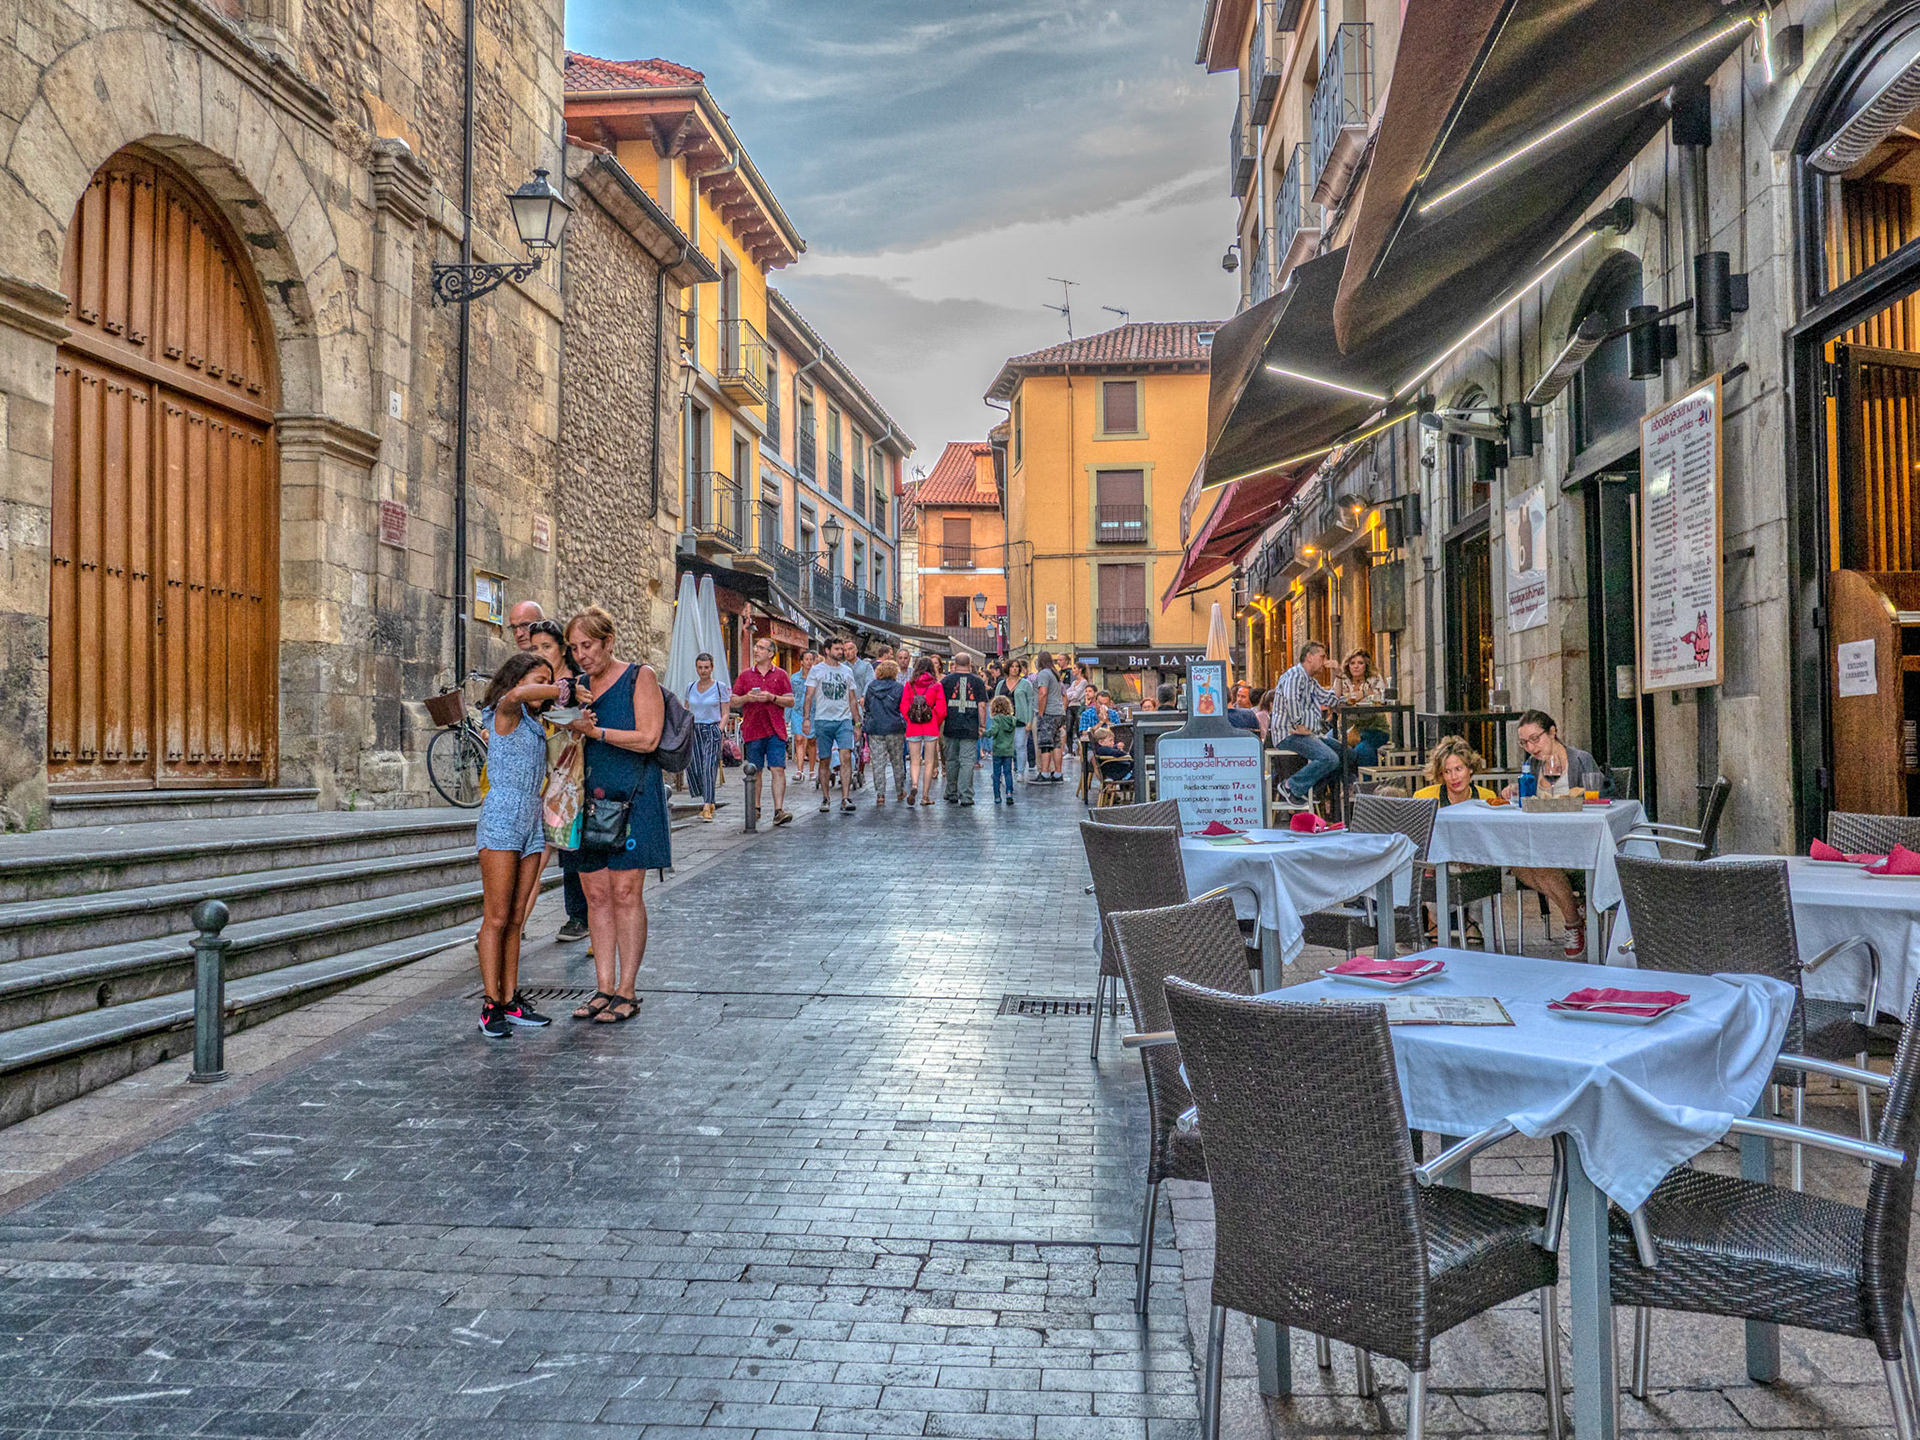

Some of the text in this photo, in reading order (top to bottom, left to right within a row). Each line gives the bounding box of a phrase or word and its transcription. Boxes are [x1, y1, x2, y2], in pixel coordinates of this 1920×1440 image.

[1128, 655, 1149, 666] Bar
[1159, 655, 1180, 666] LA
[1193, 667, 1219, 675] Sangría
